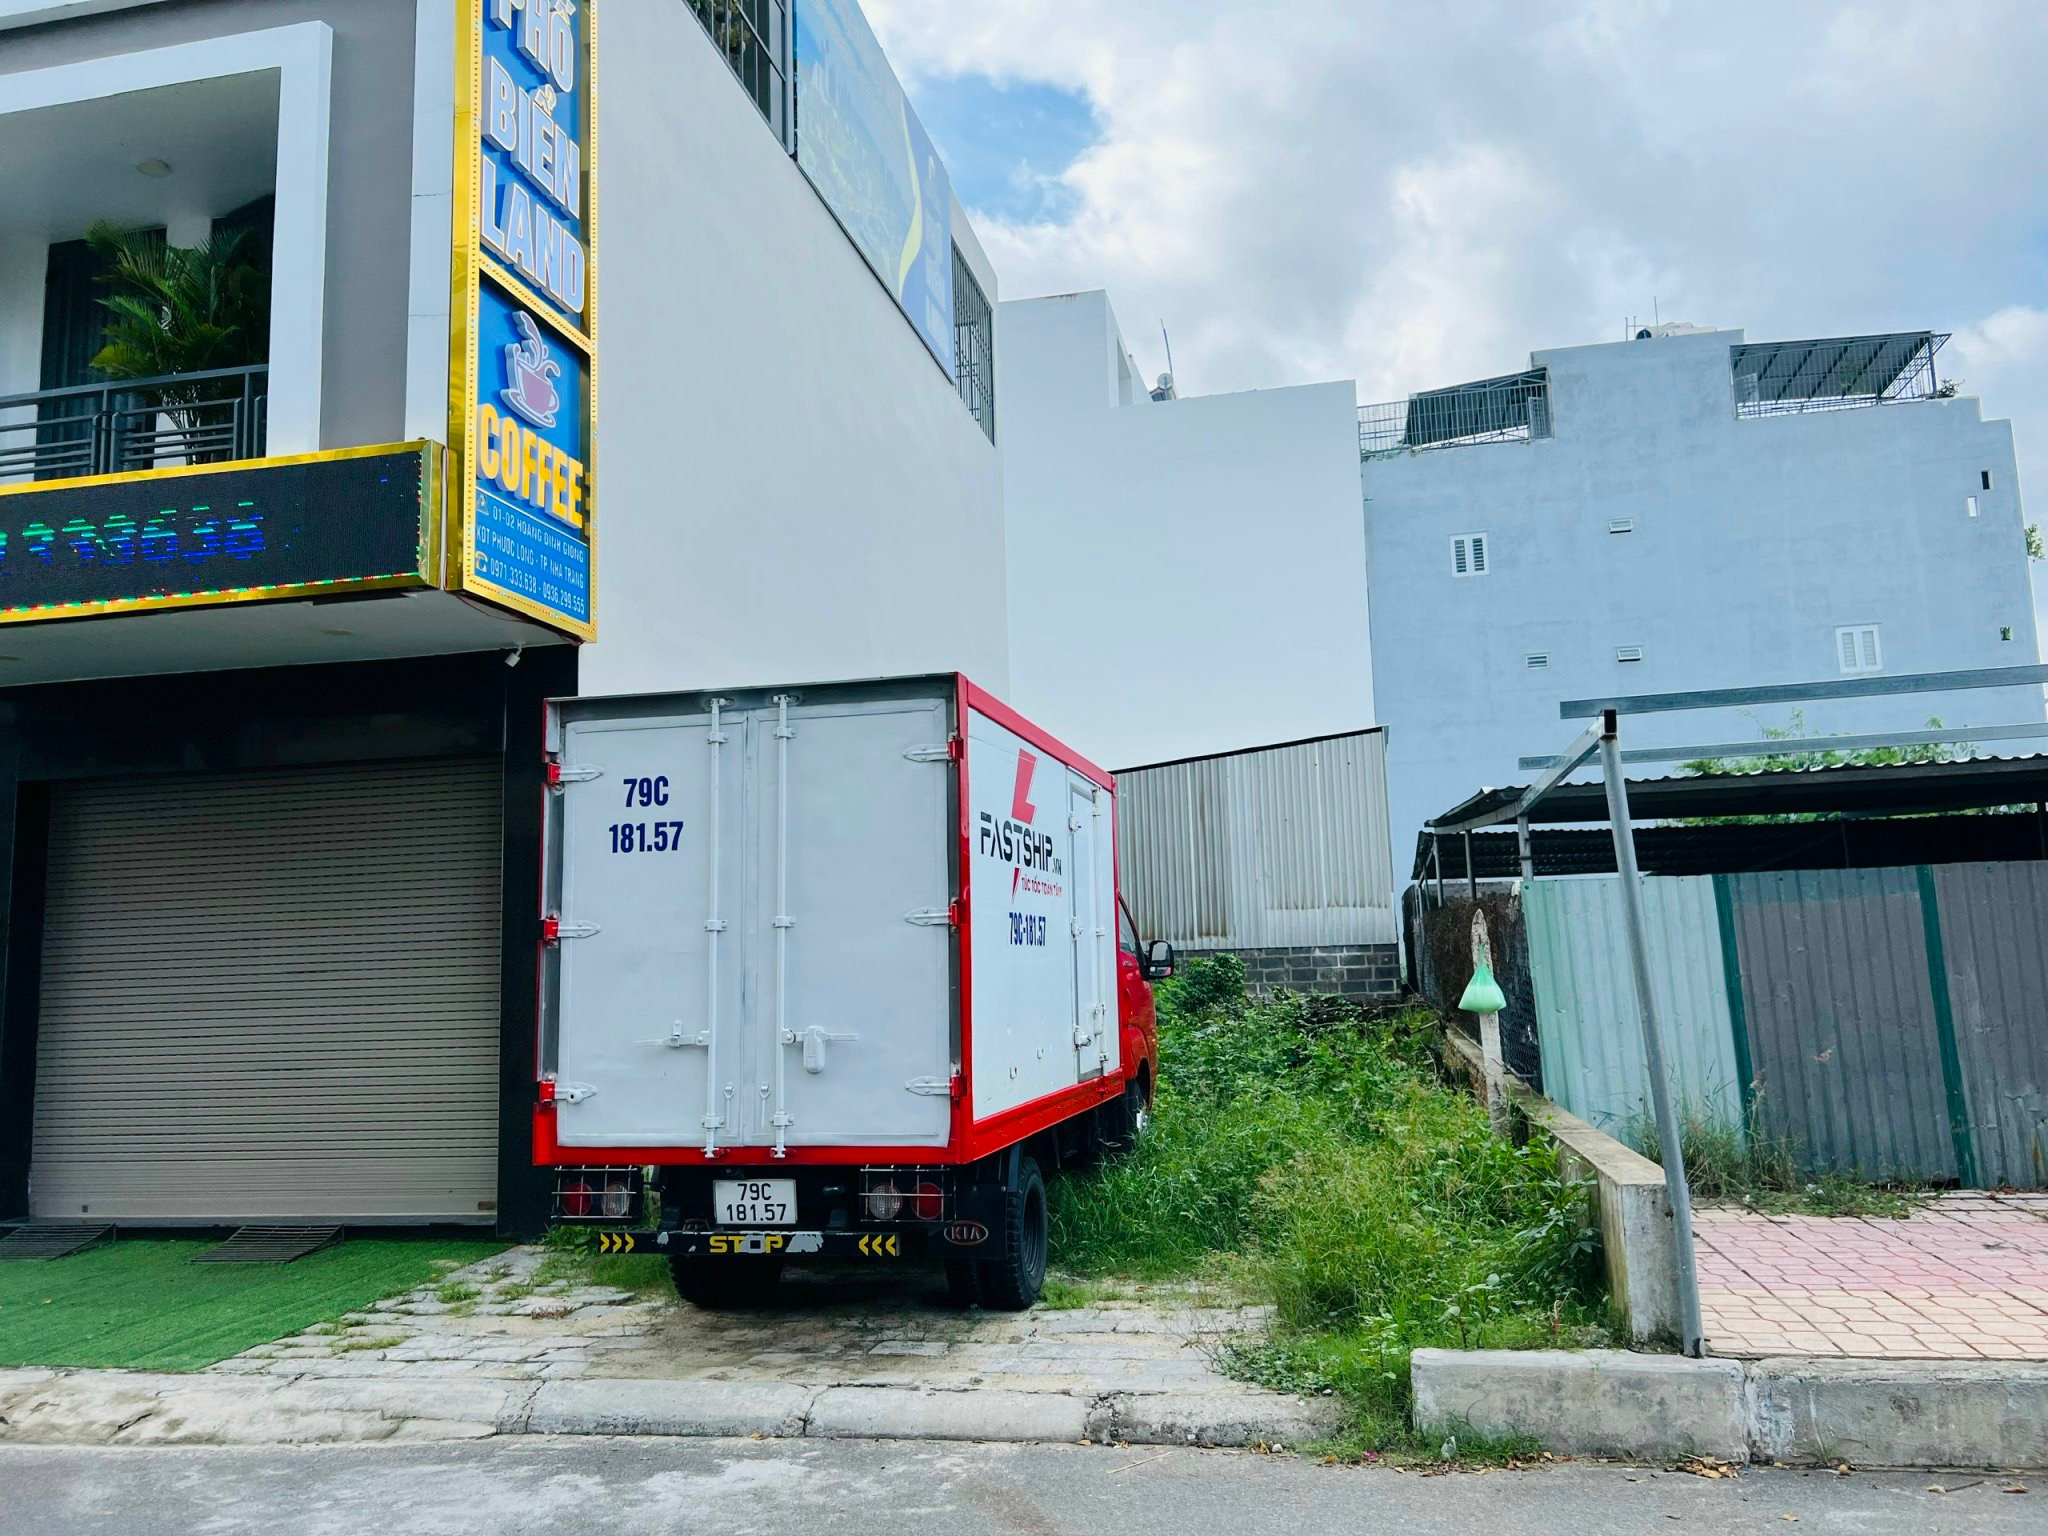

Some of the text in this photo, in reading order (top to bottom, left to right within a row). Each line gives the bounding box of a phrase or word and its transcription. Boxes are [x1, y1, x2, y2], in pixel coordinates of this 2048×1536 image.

[484, 56, 580, 219] BIỂN
[481, 155, 586, 314] LAND
[479, 403, 584, 529] COFFEE
[493, 506, 515, 529] 01-02
[490, 558, 537, 594] 0971.333.638
[516, 543, 534, 566] LONG
[550, 559, 563, 578] NHA
[564, 565, 584, 589] TRANG
[623, 775, 669, 808] 79C
[608, 821, 684, 853] 181.57
[1008, 911, 1046, 946] 79C-181.57
[737, 1183, 772, 1201] 79C
[726, 1203, 787, 1222] 181.57
[709, 1234, 784, 1254] STOP
[951, 1226, 981, 1240] KIA
